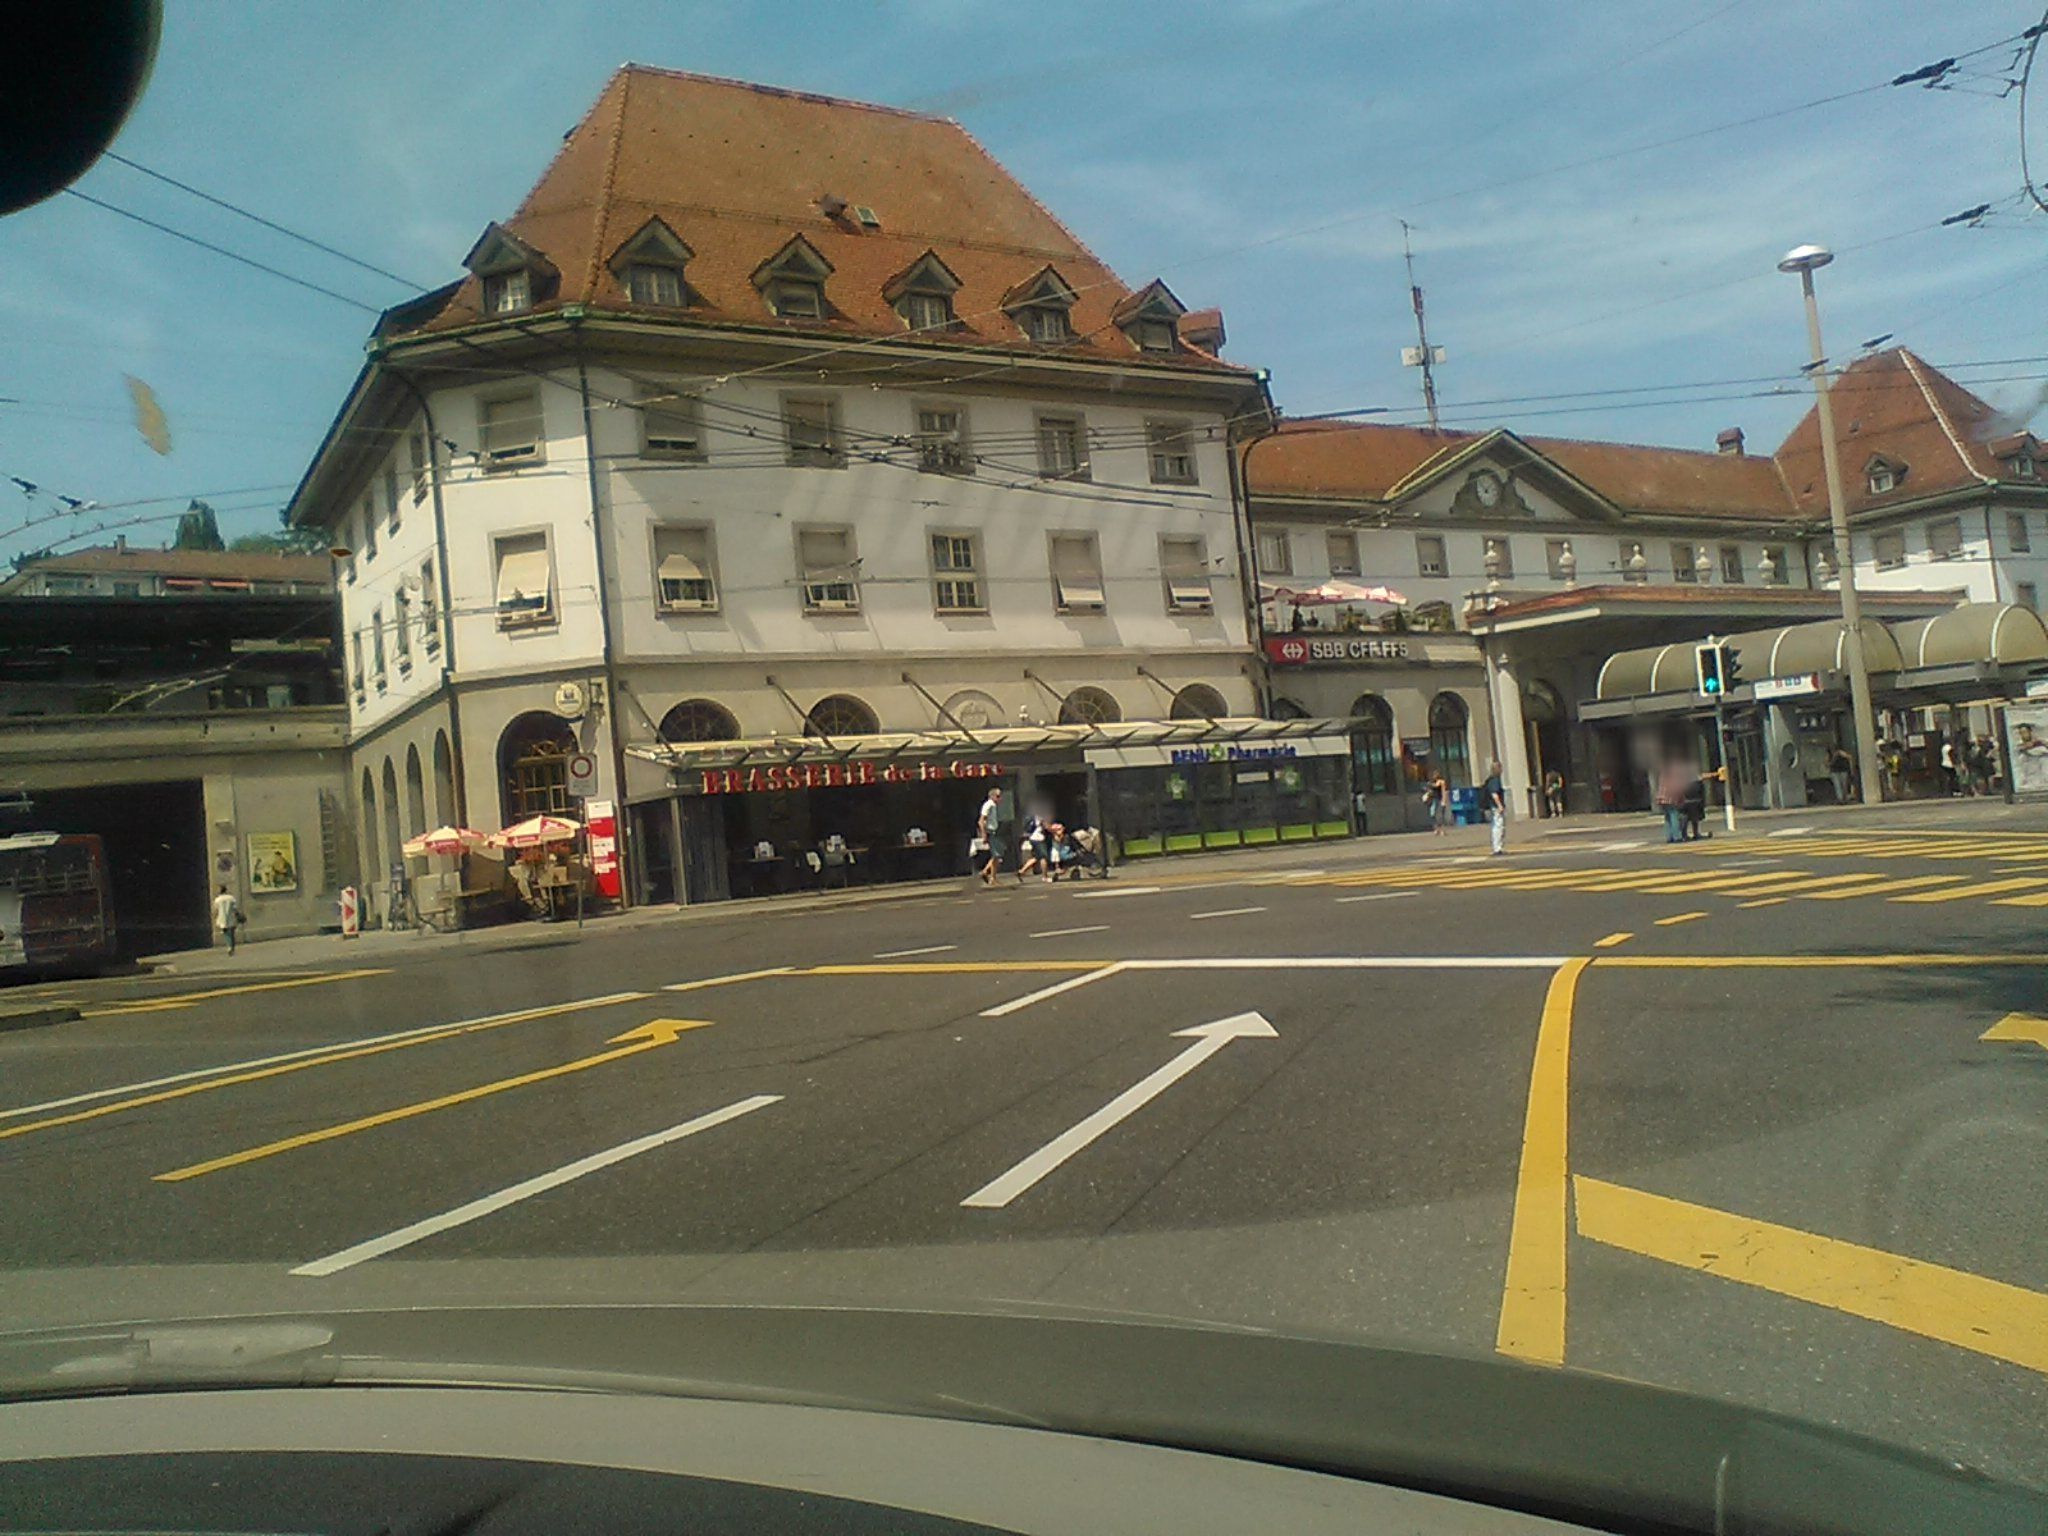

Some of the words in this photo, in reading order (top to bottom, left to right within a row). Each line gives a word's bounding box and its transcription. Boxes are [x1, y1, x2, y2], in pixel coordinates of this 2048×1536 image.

[1312, 641, 1345, 659] SBB
[1349, 641, 1380, 659] CFF
[1381, 640, 1409, 658] FFS
[1171, 747, 1210, 765] BENU
[701, 760, 876, 795] BRASSERIE
[883, 763, 913, 784] de
[919, 761, 945, 782] la
[950, 759, 1005, 779] Gare
